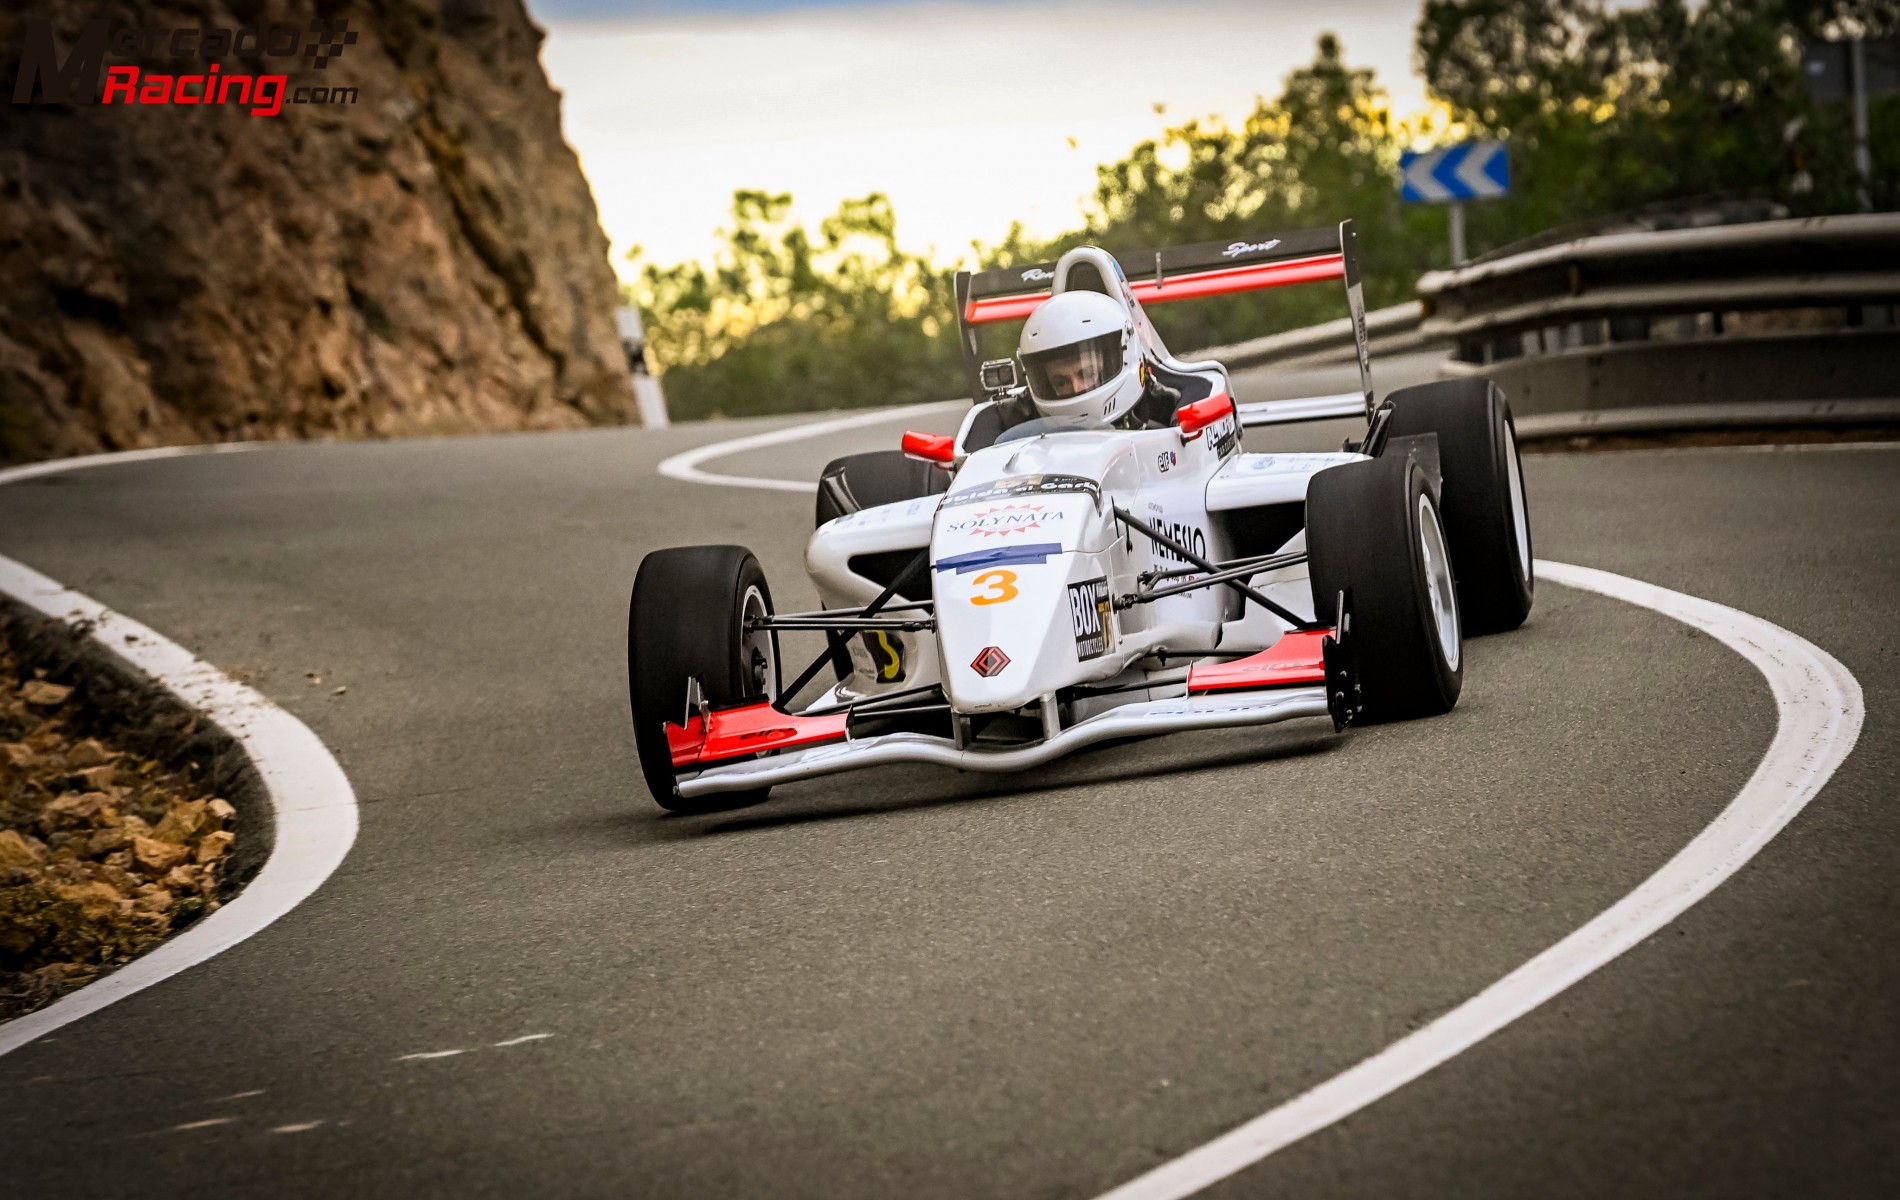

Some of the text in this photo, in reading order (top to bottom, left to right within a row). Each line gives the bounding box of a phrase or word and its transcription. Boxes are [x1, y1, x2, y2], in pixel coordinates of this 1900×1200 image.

[946, 511, 1064, 533] SOLYNATA
[970, 569, 1019, 607] 3
[1069, 583, 1101, 637] BOX
